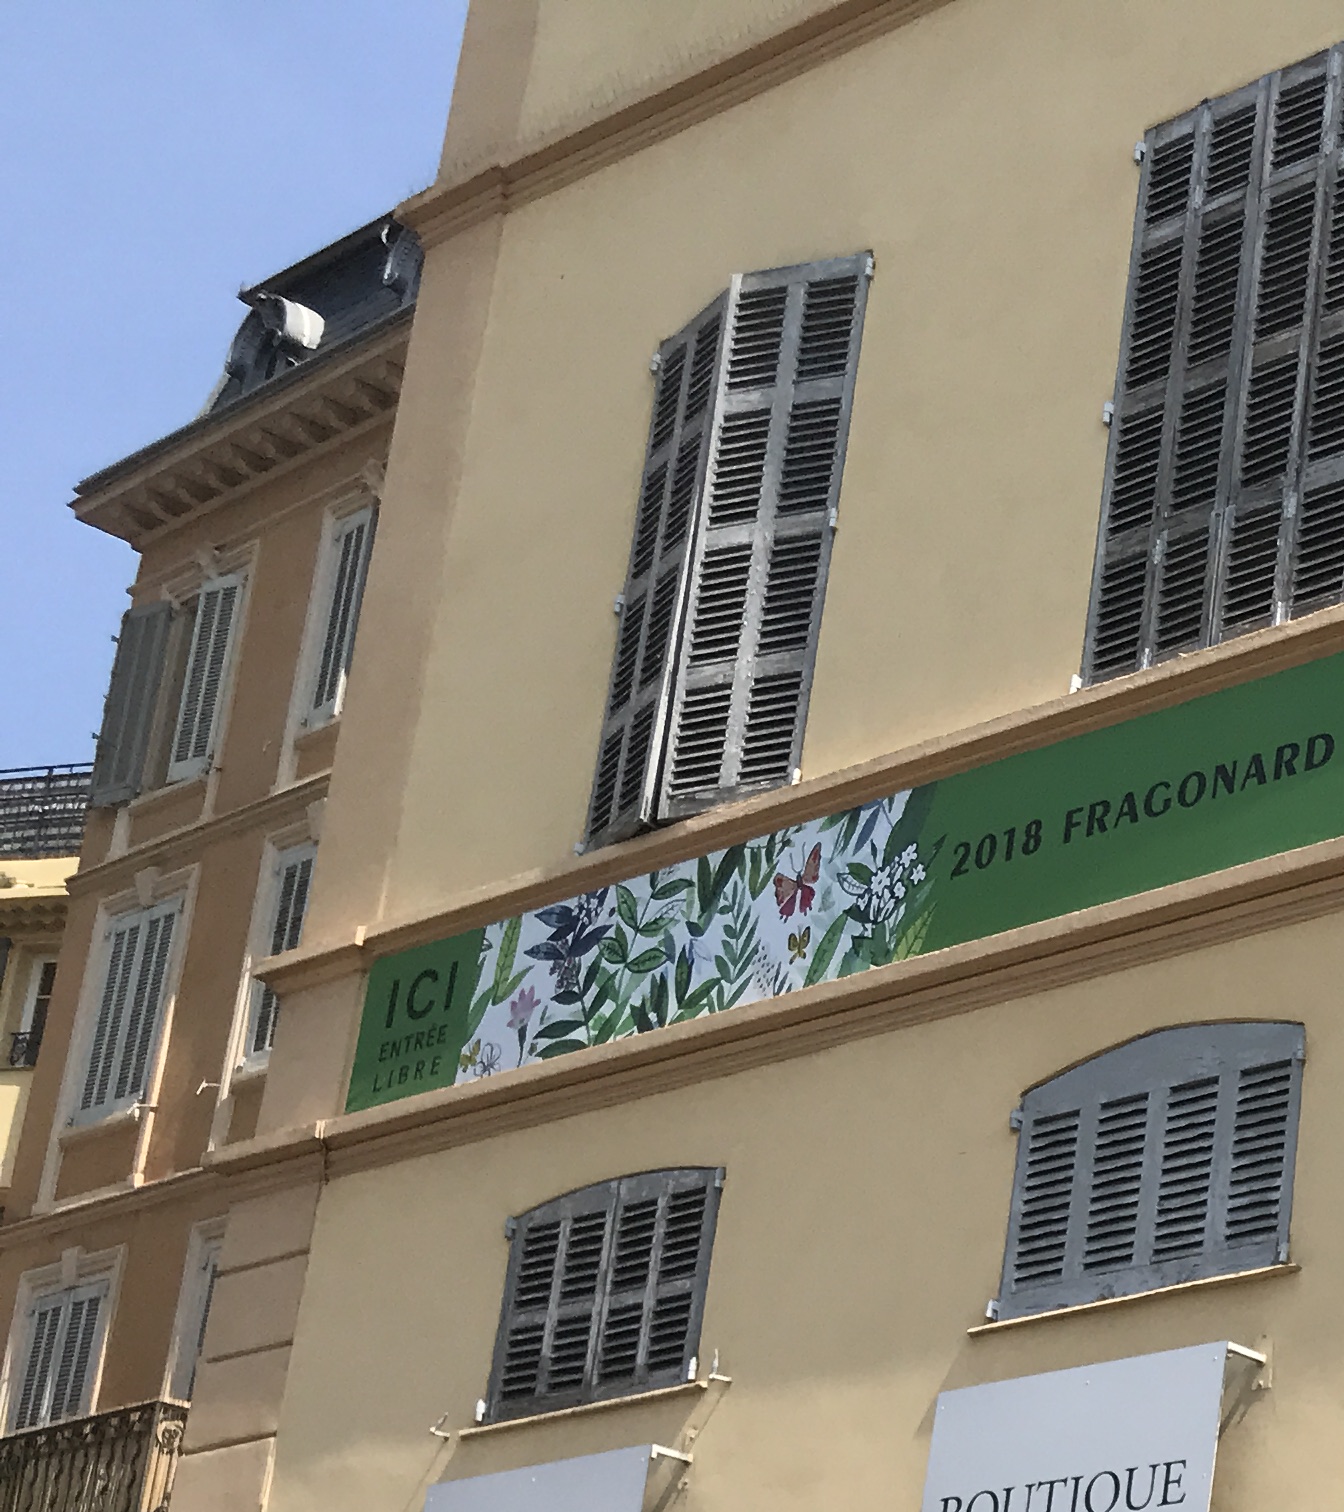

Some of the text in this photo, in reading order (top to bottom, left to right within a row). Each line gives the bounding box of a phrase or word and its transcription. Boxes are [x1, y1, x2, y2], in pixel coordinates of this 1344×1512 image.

[949, 818, 1043, 881] 2018
[1062, 732, 1335, 845] FRAGONARD
[385, 960, 459, 1029] ICI
[377, 1023, 449, 1063] ENTRÉE
[372, 1055, 443, 1093] LIBRE
